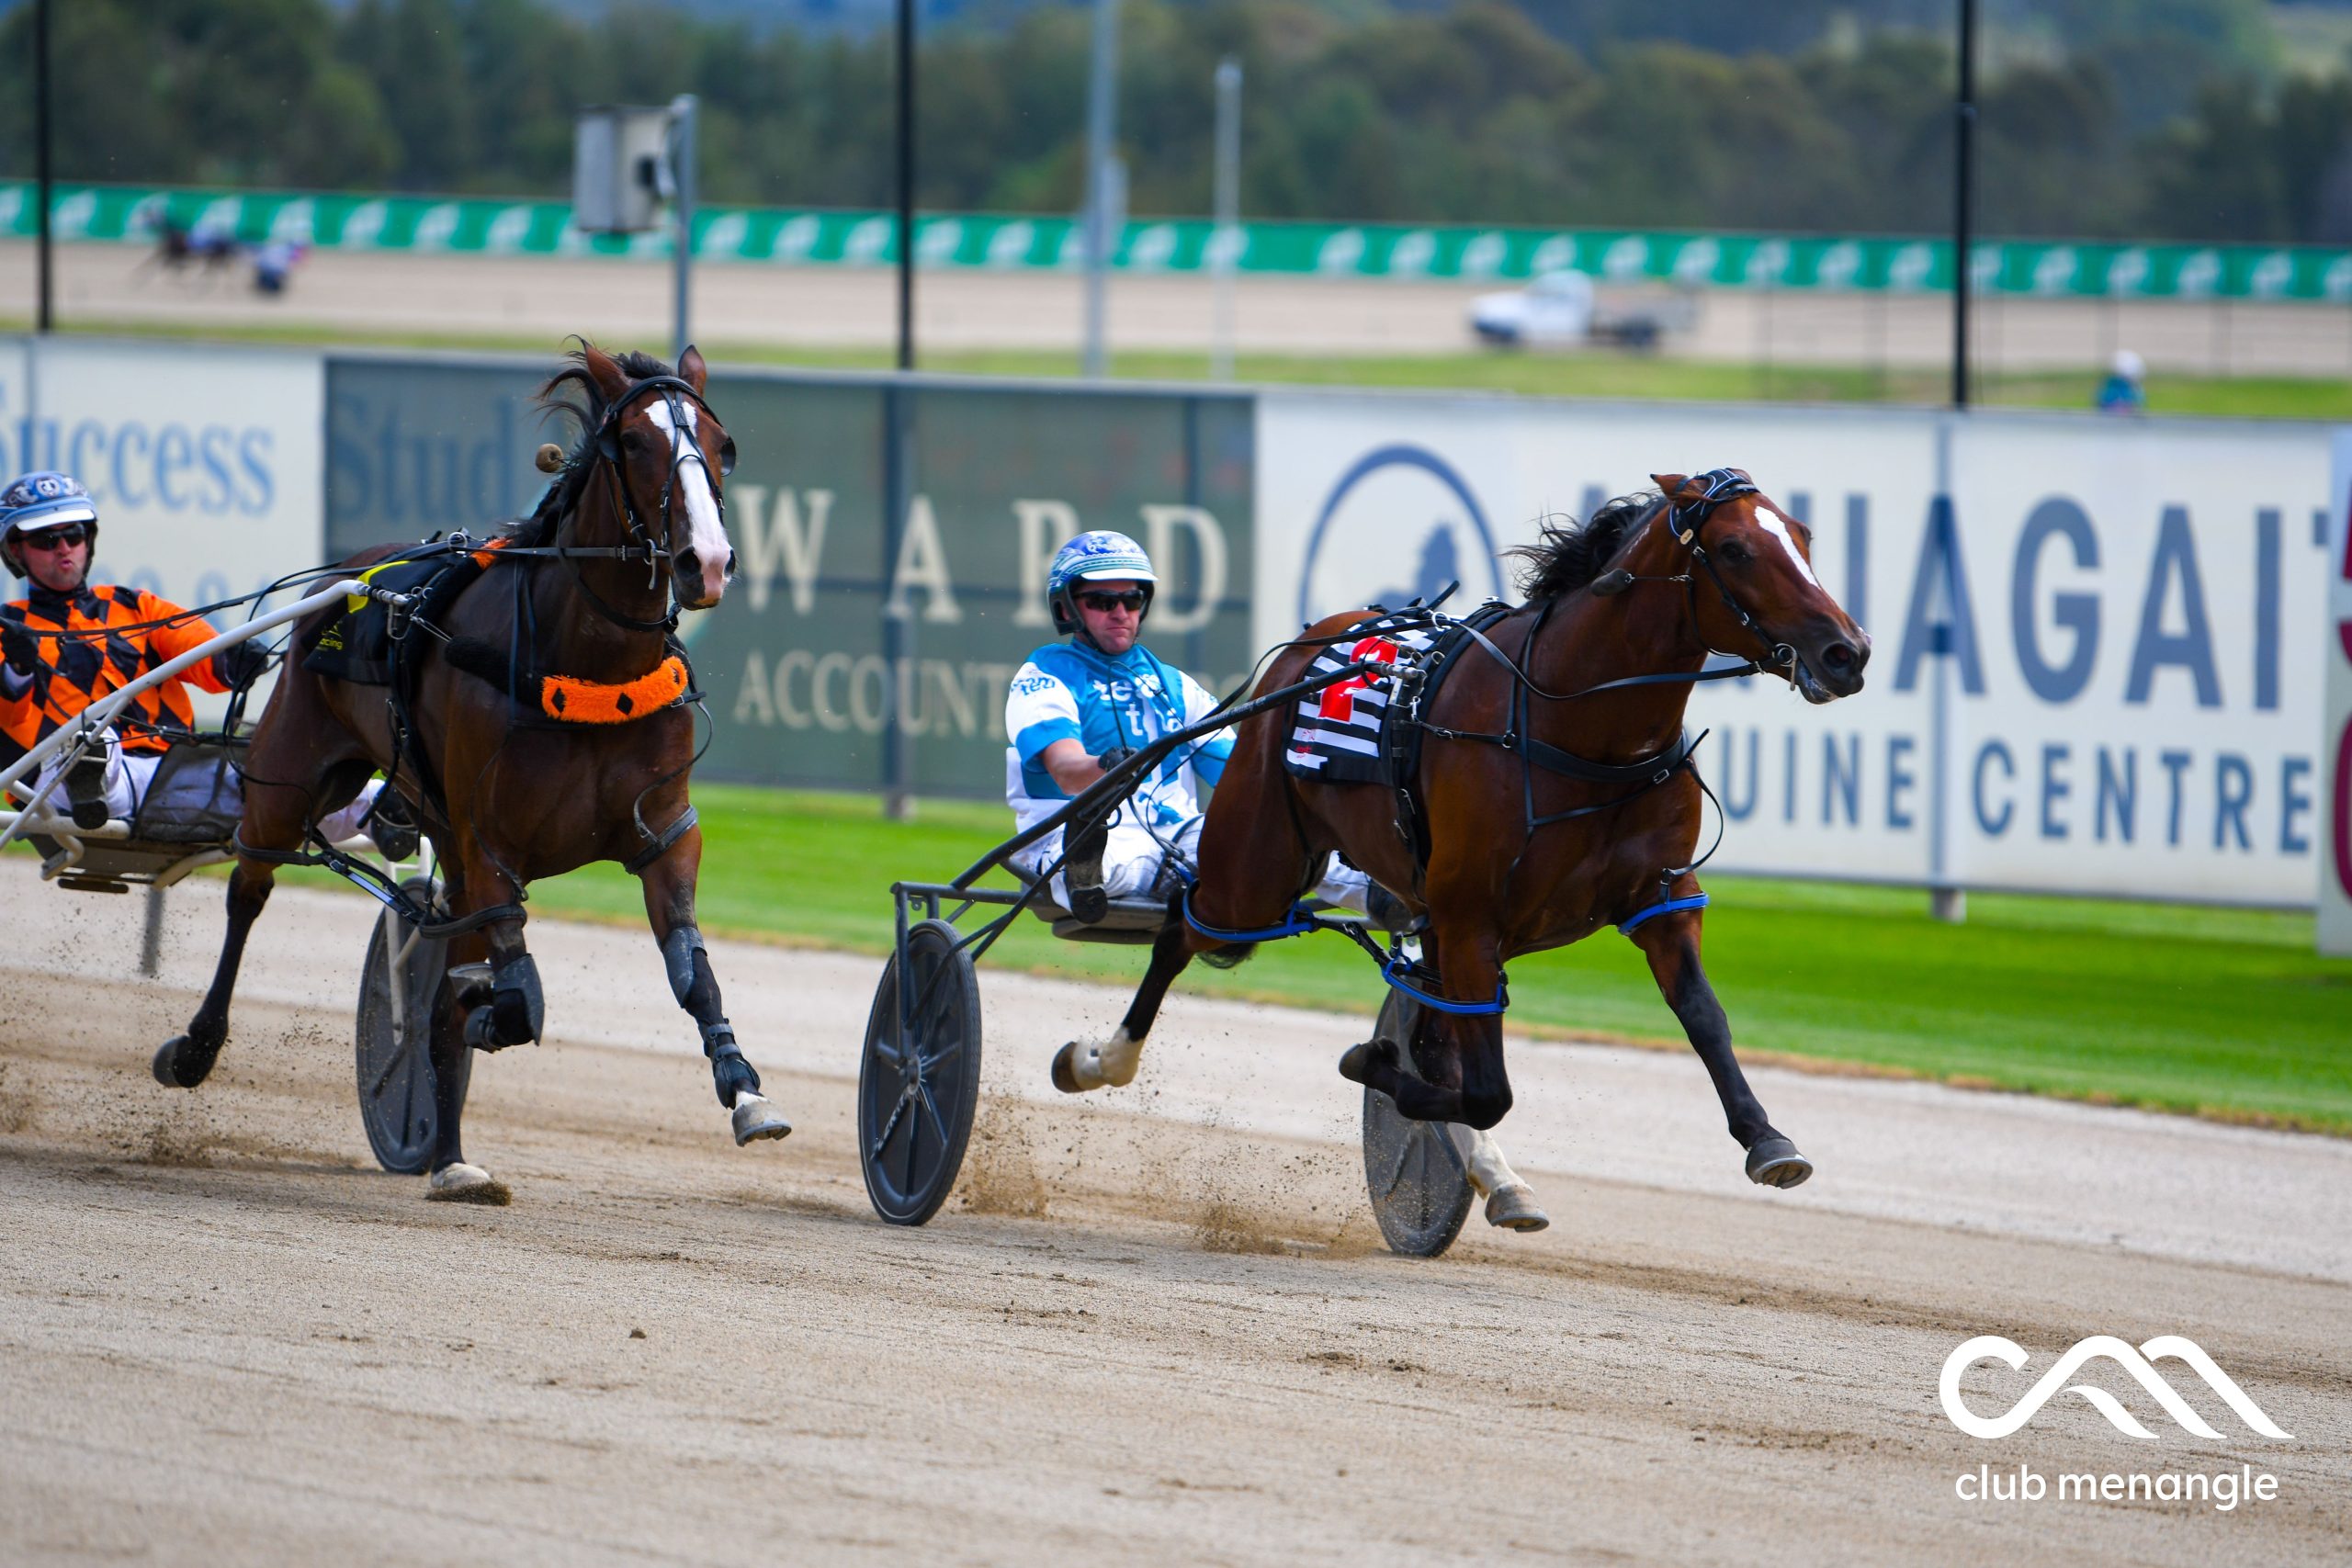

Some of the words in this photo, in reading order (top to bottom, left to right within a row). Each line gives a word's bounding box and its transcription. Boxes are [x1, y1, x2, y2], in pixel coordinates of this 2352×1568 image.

[0, 380, 274, 516] uccess
[1720, 724, 1916, 829] UINE
[1972, 739, 2313, 854] CENTRE
